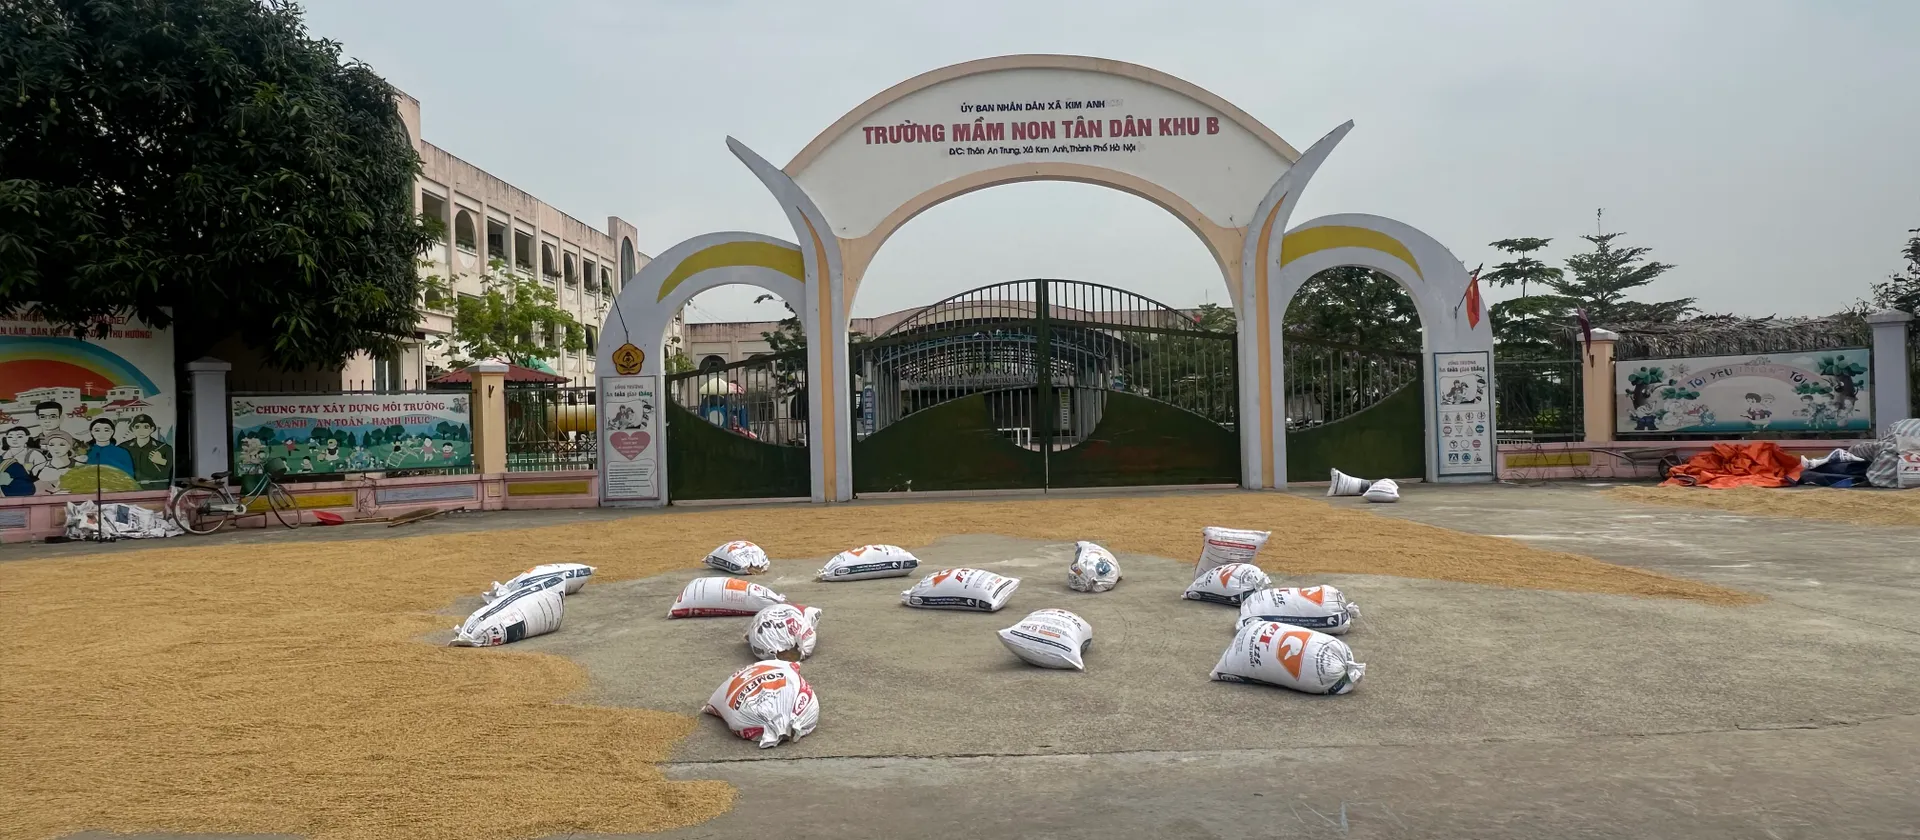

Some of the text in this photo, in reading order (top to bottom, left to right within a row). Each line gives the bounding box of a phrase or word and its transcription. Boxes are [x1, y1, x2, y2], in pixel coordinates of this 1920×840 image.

[961, 101, 974, 113] ỦY
[976, 104, 995, 113] BAN
[997, 101, 1023, 112] NHÂN
[1025, 101, 1045, 111] DÂN
[1048, 99, 1062, 110] XÃ
[1065, 101, 1082, 110] KIM
[1086, 100, 1105, 109] ANH
[863, 114, 1220, 145] TRƯỜNG MẦM NON TÂN DÂN KHU B
[987, 146, 998, 155] An
[1000, 146, 1021, 156] Trung,
[1035, 146, 1050, 154] Kim
[1093, 143, 1108, 153] Phố
[1110, 143, 1121, 152] Hà
[1123, 143, 1136, 153] Nội
[256, 405, 296, 414] CHUNG
[299, 404, 320, 414] TAY
[323, 402, 346, 414] XÂY
[349, 403, 380, 414] DỰNG
[382, 401, 401, 412] MÔI
[734, 672, 785, 711] COMFEED
